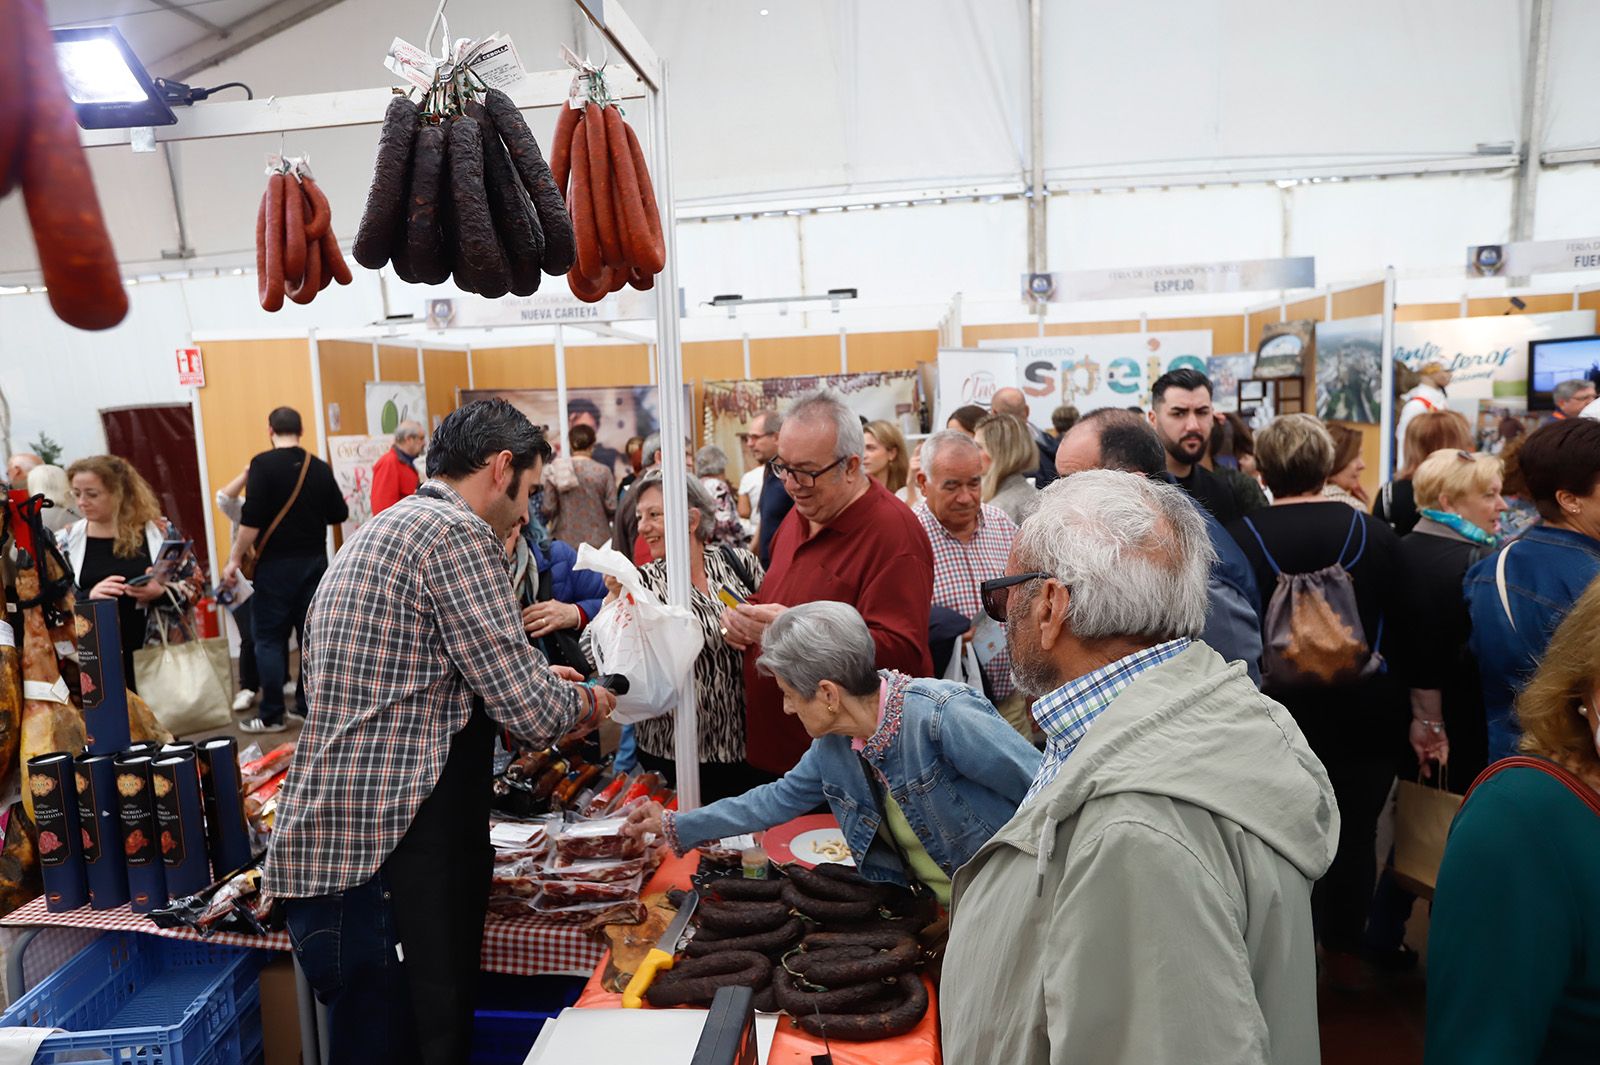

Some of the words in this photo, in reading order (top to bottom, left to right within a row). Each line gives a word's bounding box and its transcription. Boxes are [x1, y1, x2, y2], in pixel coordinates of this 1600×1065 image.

[482, 45, 509, 60] CEBOLLA
[1566, 242, 1591, 252] FERIA
[1574, 255, 1600, 268] FUE
[1153, 279, 1194, 293] ESPEJO
[521, 308, 551, 321] NUEVA
[554, 306, 598, 319] CARTEYA
[1023, 345, 1075, 358] Turismo
